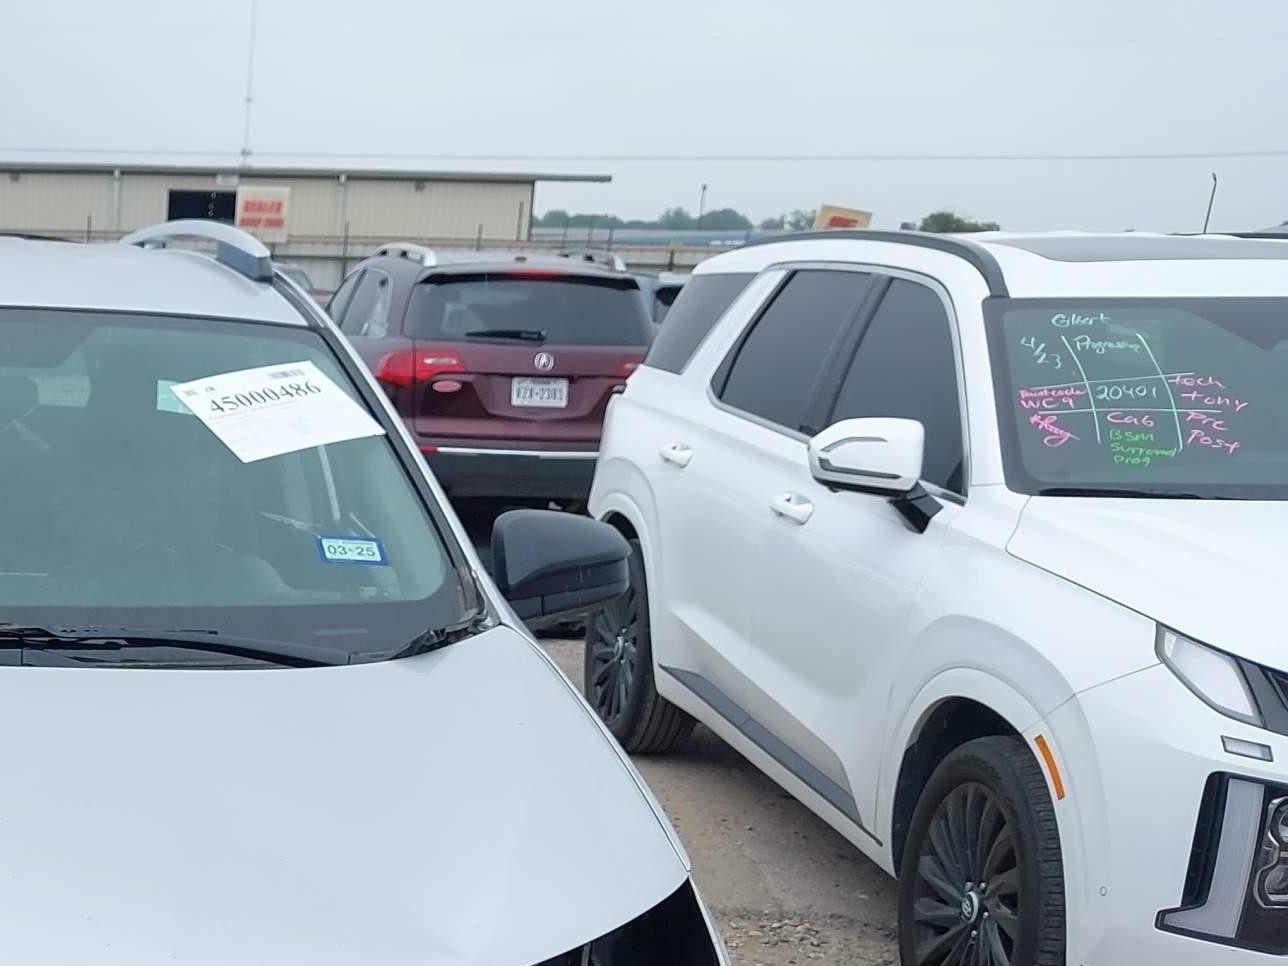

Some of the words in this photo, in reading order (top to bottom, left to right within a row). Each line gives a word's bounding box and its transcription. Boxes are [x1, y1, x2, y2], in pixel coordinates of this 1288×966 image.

[1021, 337, 1062, 369] 4/23
[210, 380, 322, 413] 45000486
[1096, 385, 1157, 401] 20401
